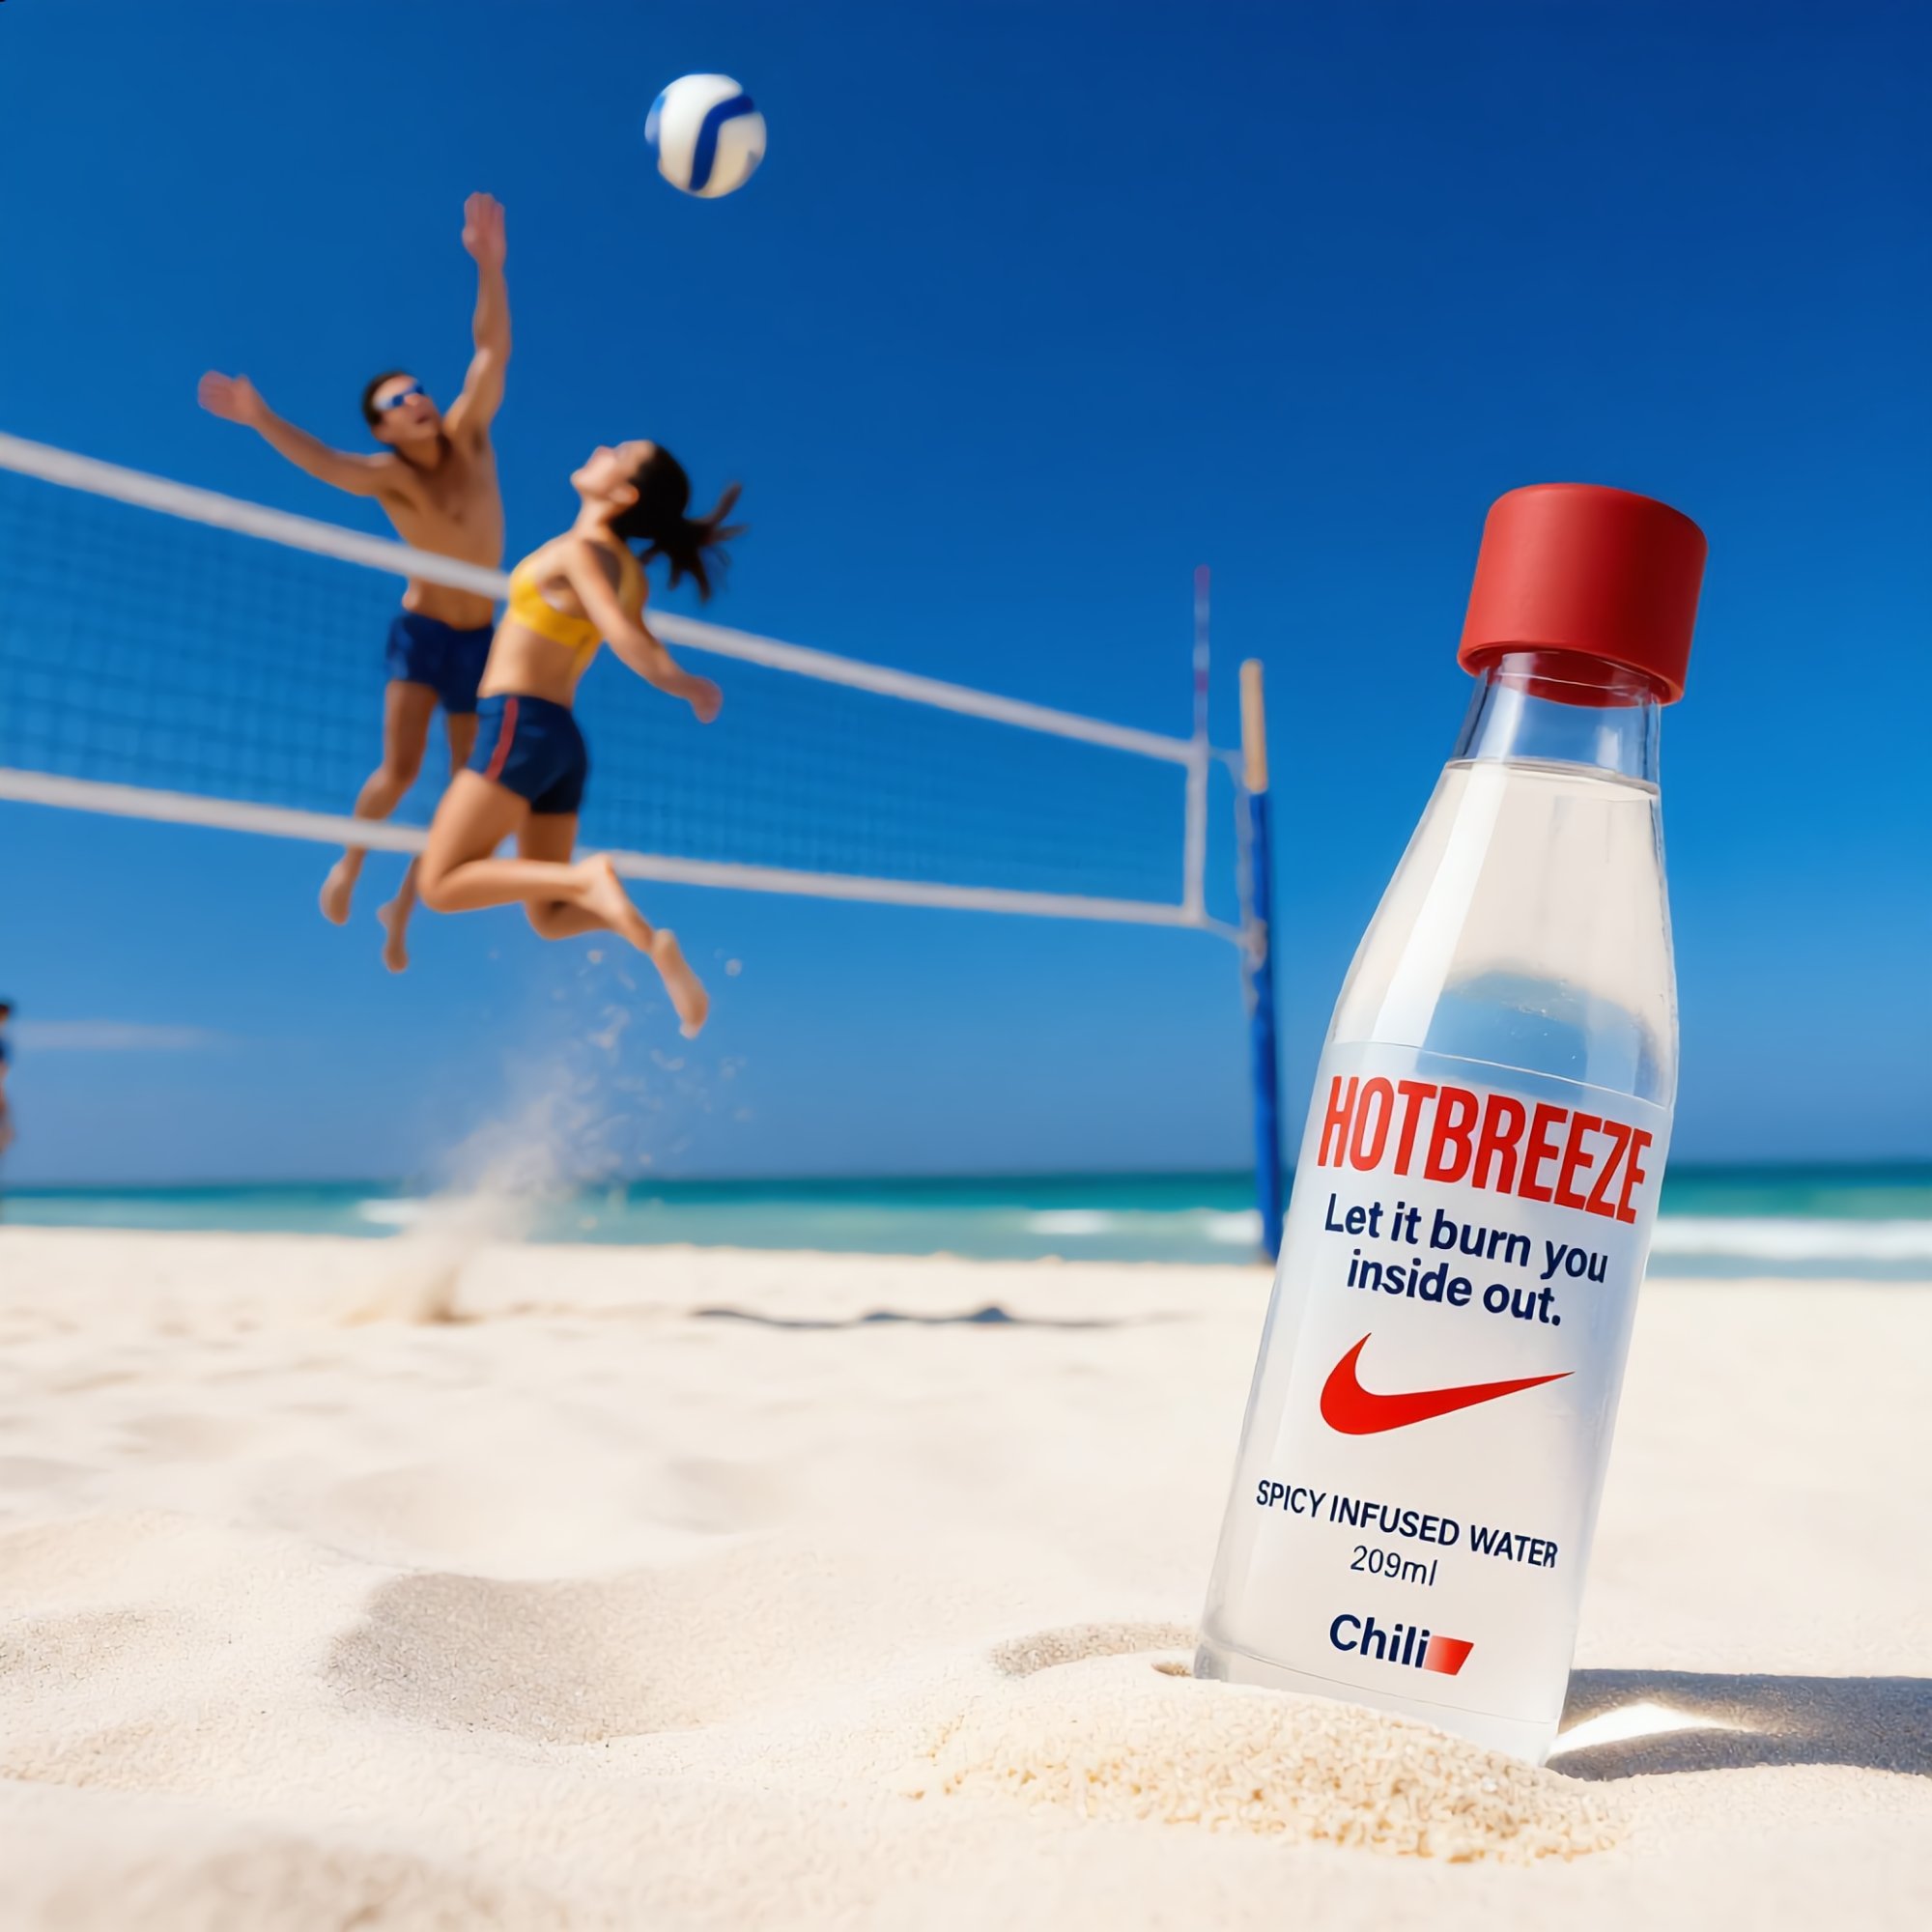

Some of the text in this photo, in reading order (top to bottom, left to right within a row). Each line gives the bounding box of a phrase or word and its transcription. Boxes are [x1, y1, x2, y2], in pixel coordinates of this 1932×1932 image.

[1317, 1075, 1653, 1225] HOTBREEZE
[1324, 1193, 1608, 1284] Let it burn you
[1347, 1248, 1561, 1326] inside out.
[1256, 1479, 1558, 1569] SPICY INFUSED WATER
[1350, 1545, 1438, 1586] 209ml
[1329, 1613, 1431, 1668] Chili
